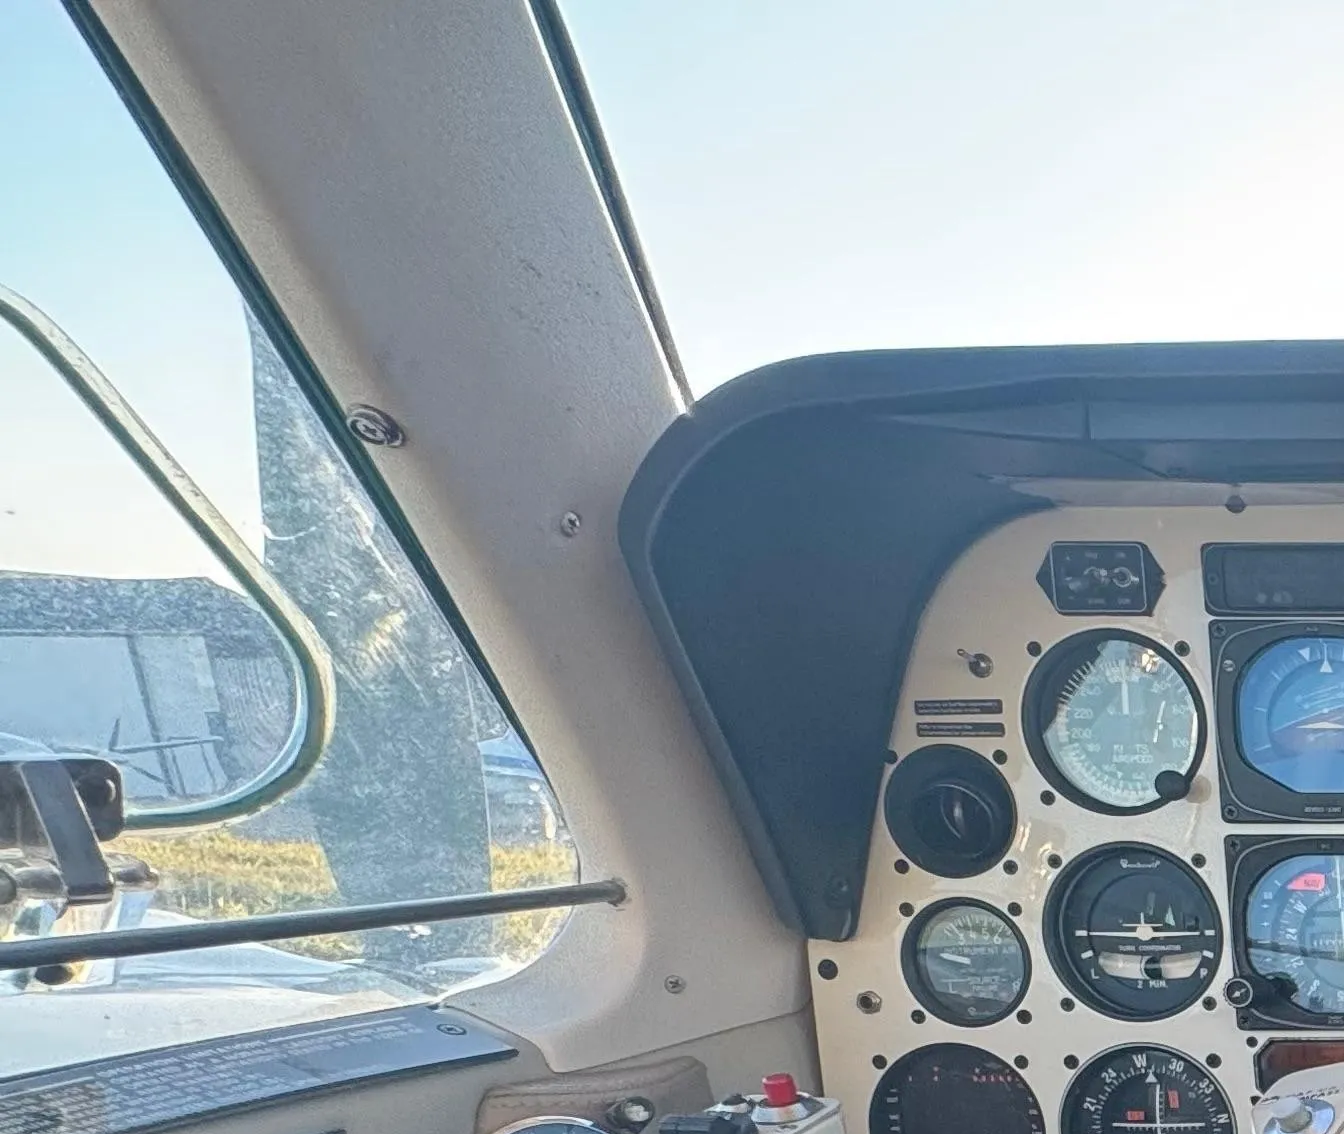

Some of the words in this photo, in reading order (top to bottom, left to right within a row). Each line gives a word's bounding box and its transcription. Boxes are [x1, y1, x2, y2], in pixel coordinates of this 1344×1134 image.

[1074, 709, 1093, 719] 220
[1132, 1054, 1147, 1068] W
[1168, 1058, 1184, 1073] 30
[1101, 1068, 1117, 1084] 24
[1199, 1077, 1214, 1093] 33
[1083, 1097, 1098, 1111] 21
[1216, 1113, 1230, 1125] N
